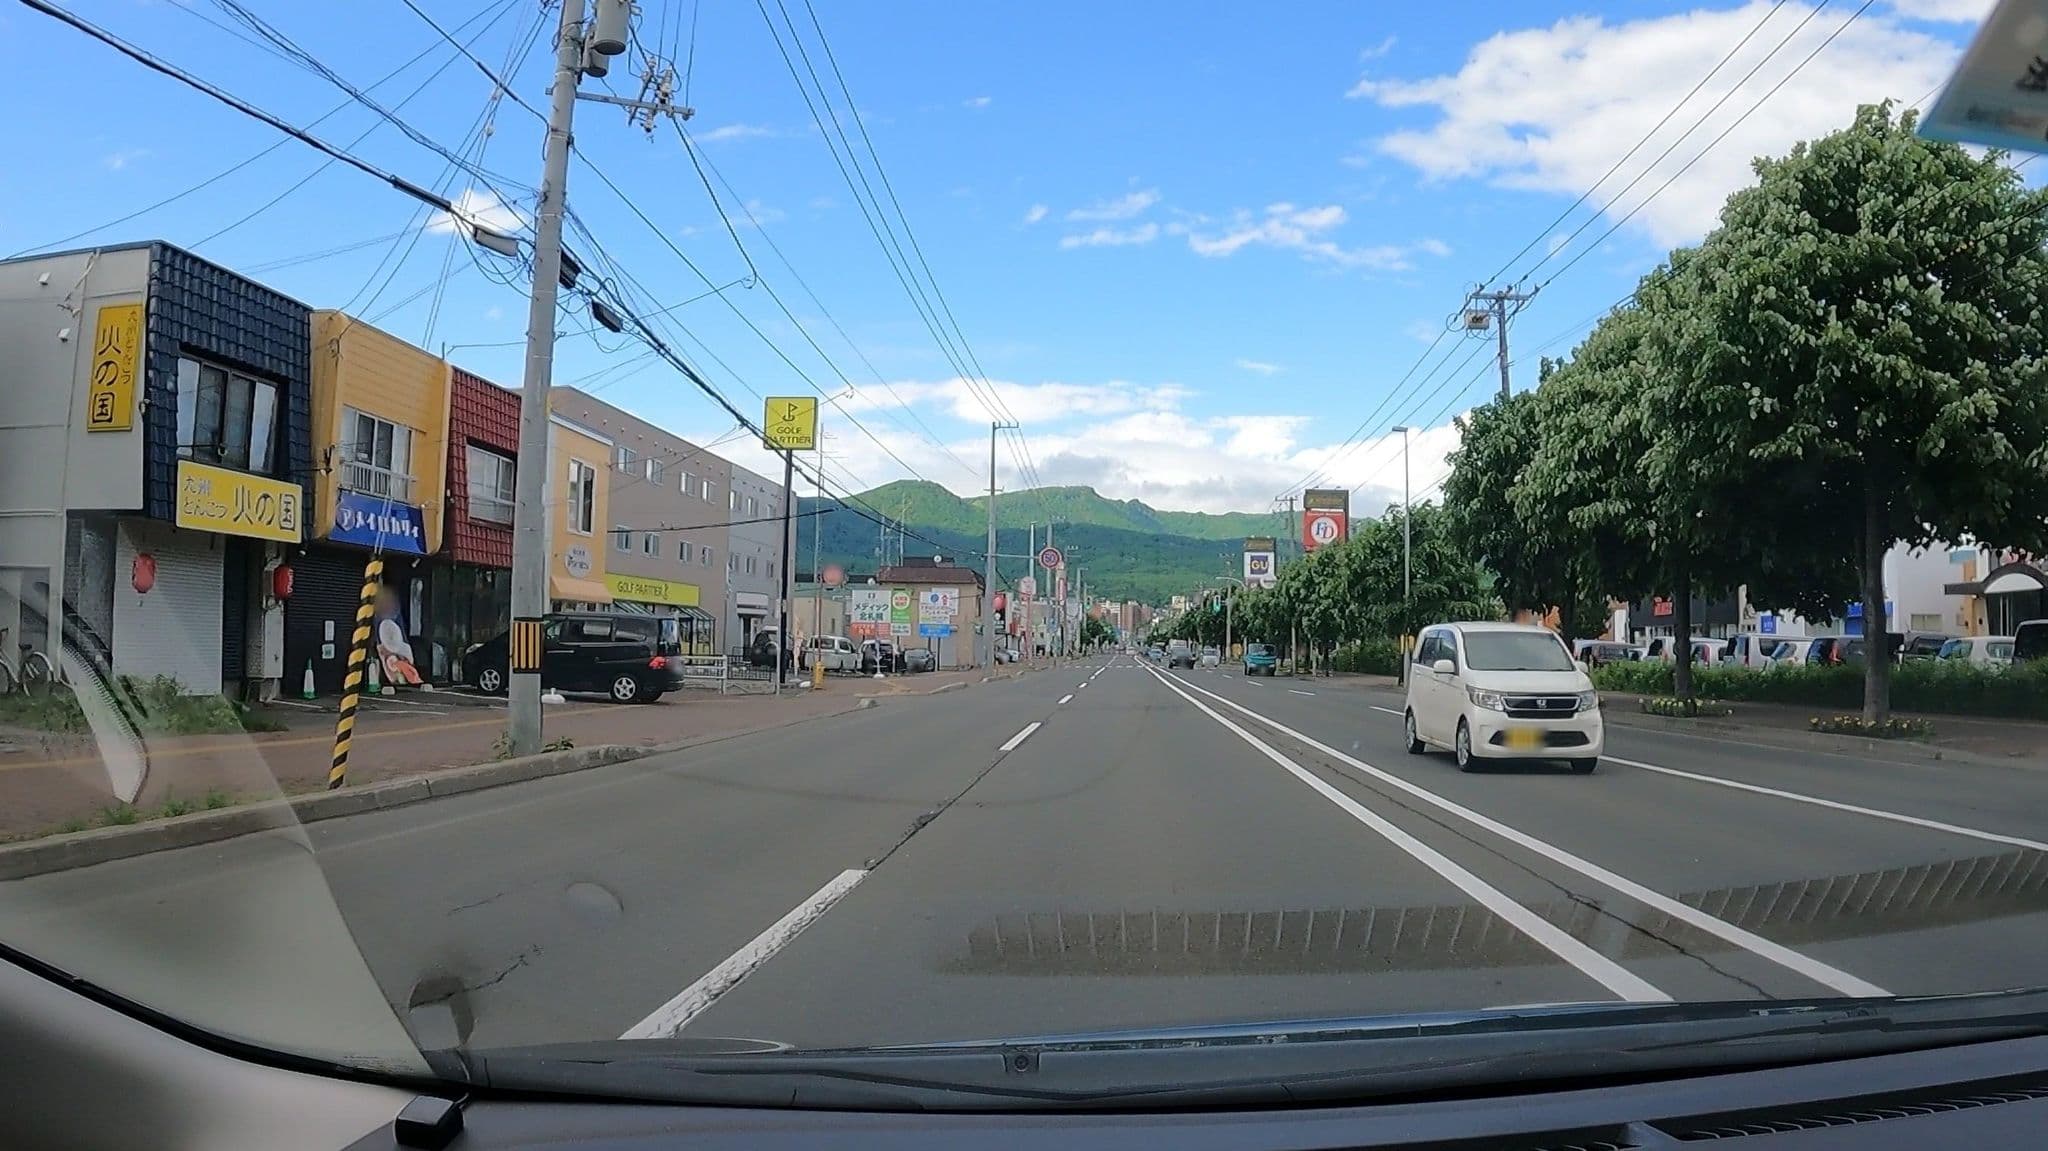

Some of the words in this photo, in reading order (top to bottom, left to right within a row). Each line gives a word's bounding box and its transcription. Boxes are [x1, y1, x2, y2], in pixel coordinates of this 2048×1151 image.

[92, 325, 122, 424] 火の国
[776, 426, 802, 435] GOLF
[184, 476, 211, 497] 九州
[184, 496, 228, 519] とんこつ
[233, 485, 296, 532] 火の国
[1044, 552, 1058, 564] 50
[1251, 560, 1270, 570] GU
[617, 580, 635, 593] GOLF
